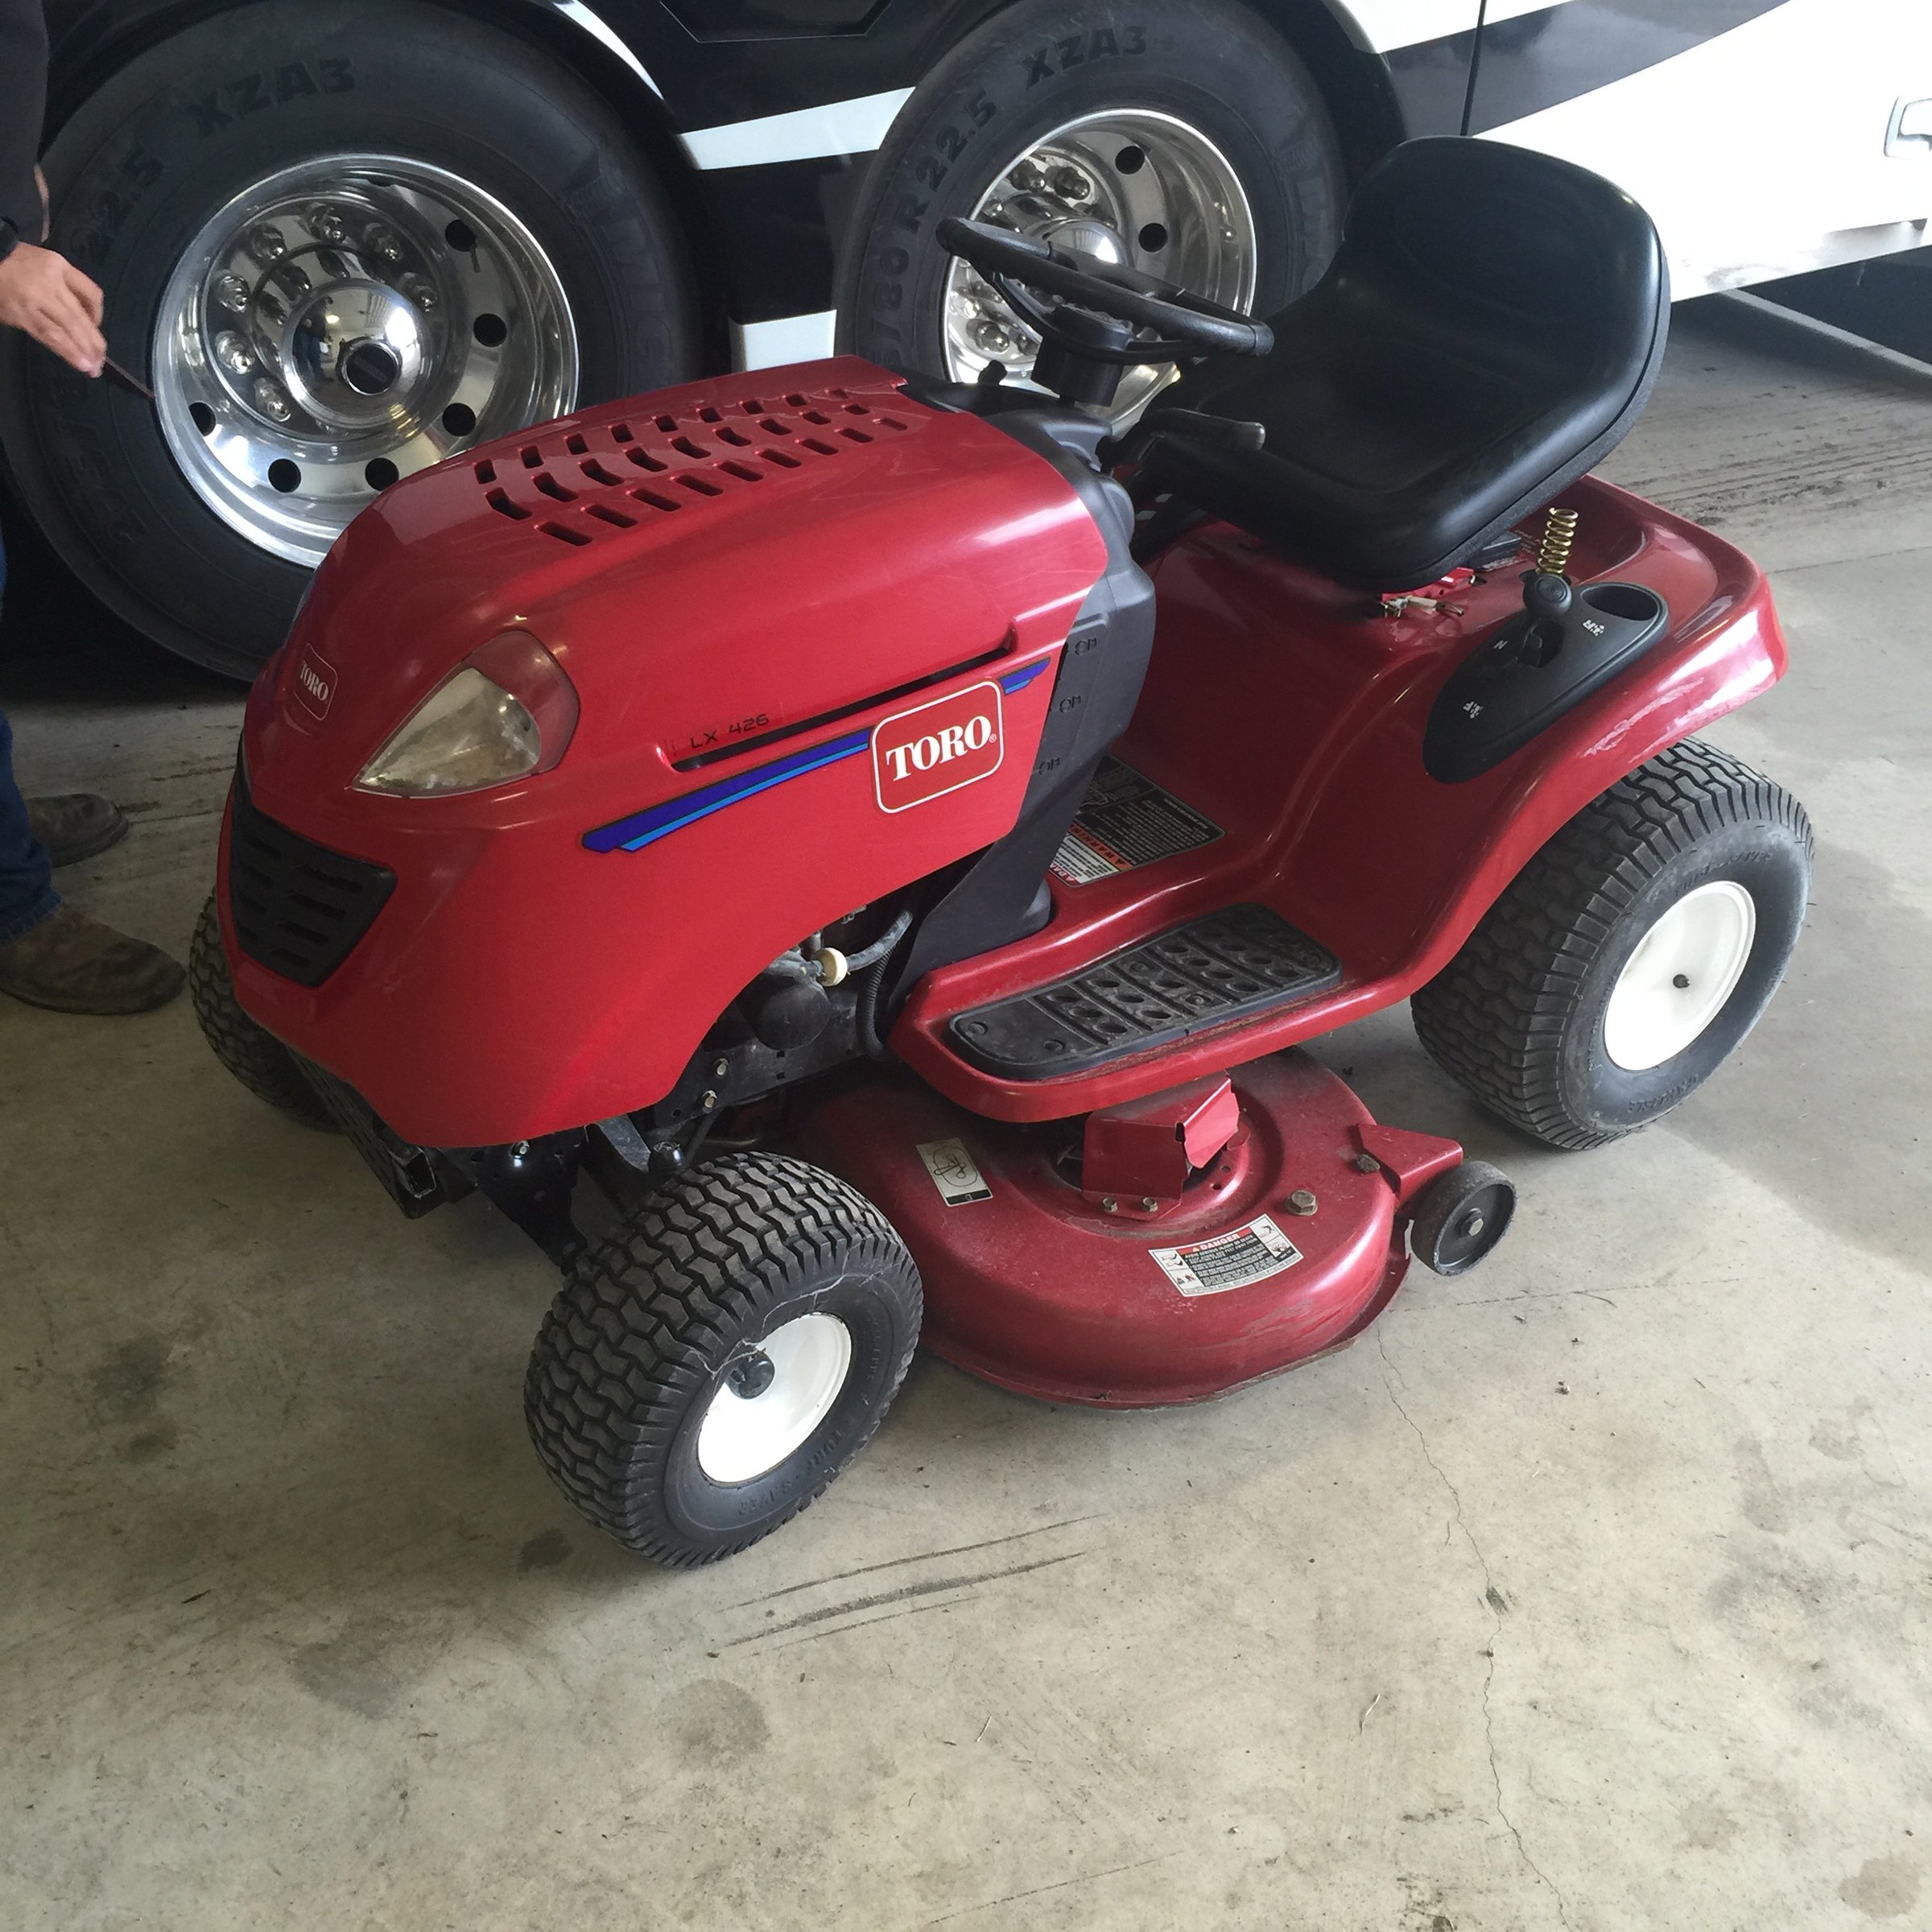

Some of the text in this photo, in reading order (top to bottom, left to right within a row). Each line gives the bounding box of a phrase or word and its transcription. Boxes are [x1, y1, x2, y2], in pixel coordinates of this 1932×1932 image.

[1021, 25, 1147, 91] XZA3
[181, 56, 357, 142] XZA3
[299, 659, 329, 702] TORO
[690, 713, 770, 749] LX 426
[1199, 1233, 1241, 1250] DANGER
